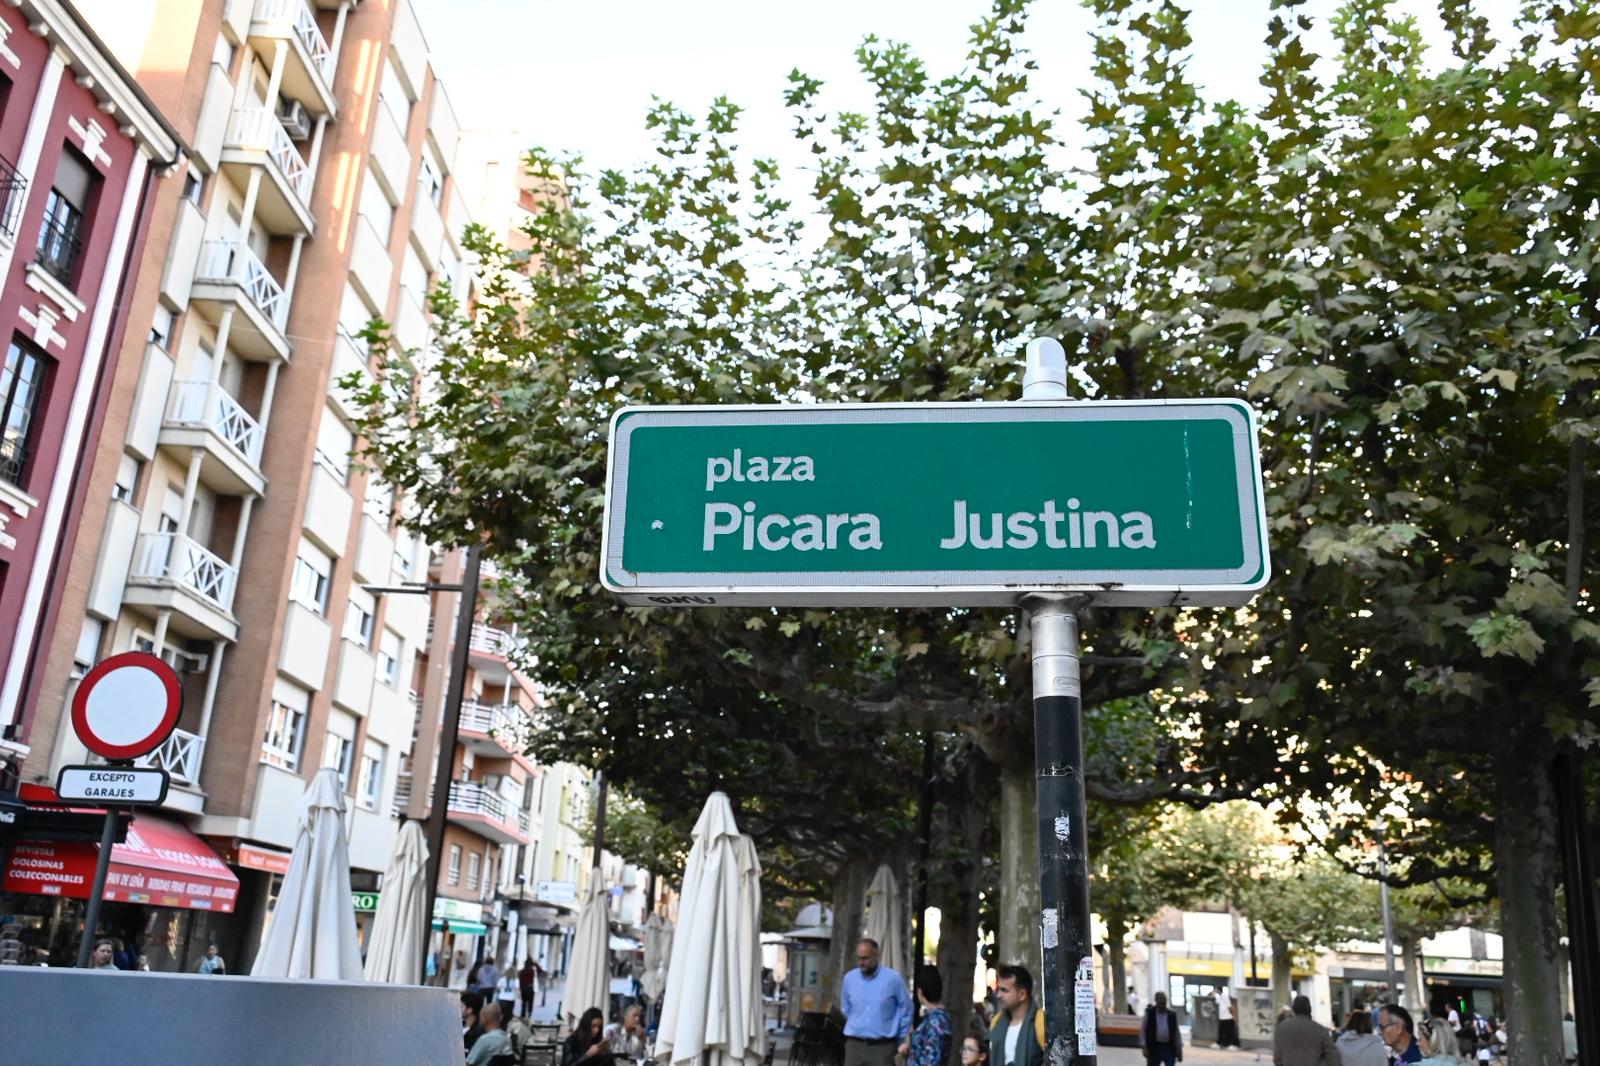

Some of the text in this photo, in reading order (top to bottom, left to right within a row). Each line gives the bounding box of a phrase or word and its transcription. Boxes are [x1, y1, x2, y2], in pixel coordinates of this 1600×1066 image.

[706, 448, 816, 491] plaza
[703, 498, 1157, 551] Picara Justina
[89, 772, 136, 783] EXCEPTO
[84, 787, 135, 798] GARAJES
[12, 858, 65, 870] GOLOSINAS
[9, 869, 84, 884] COLECCIONABLES
